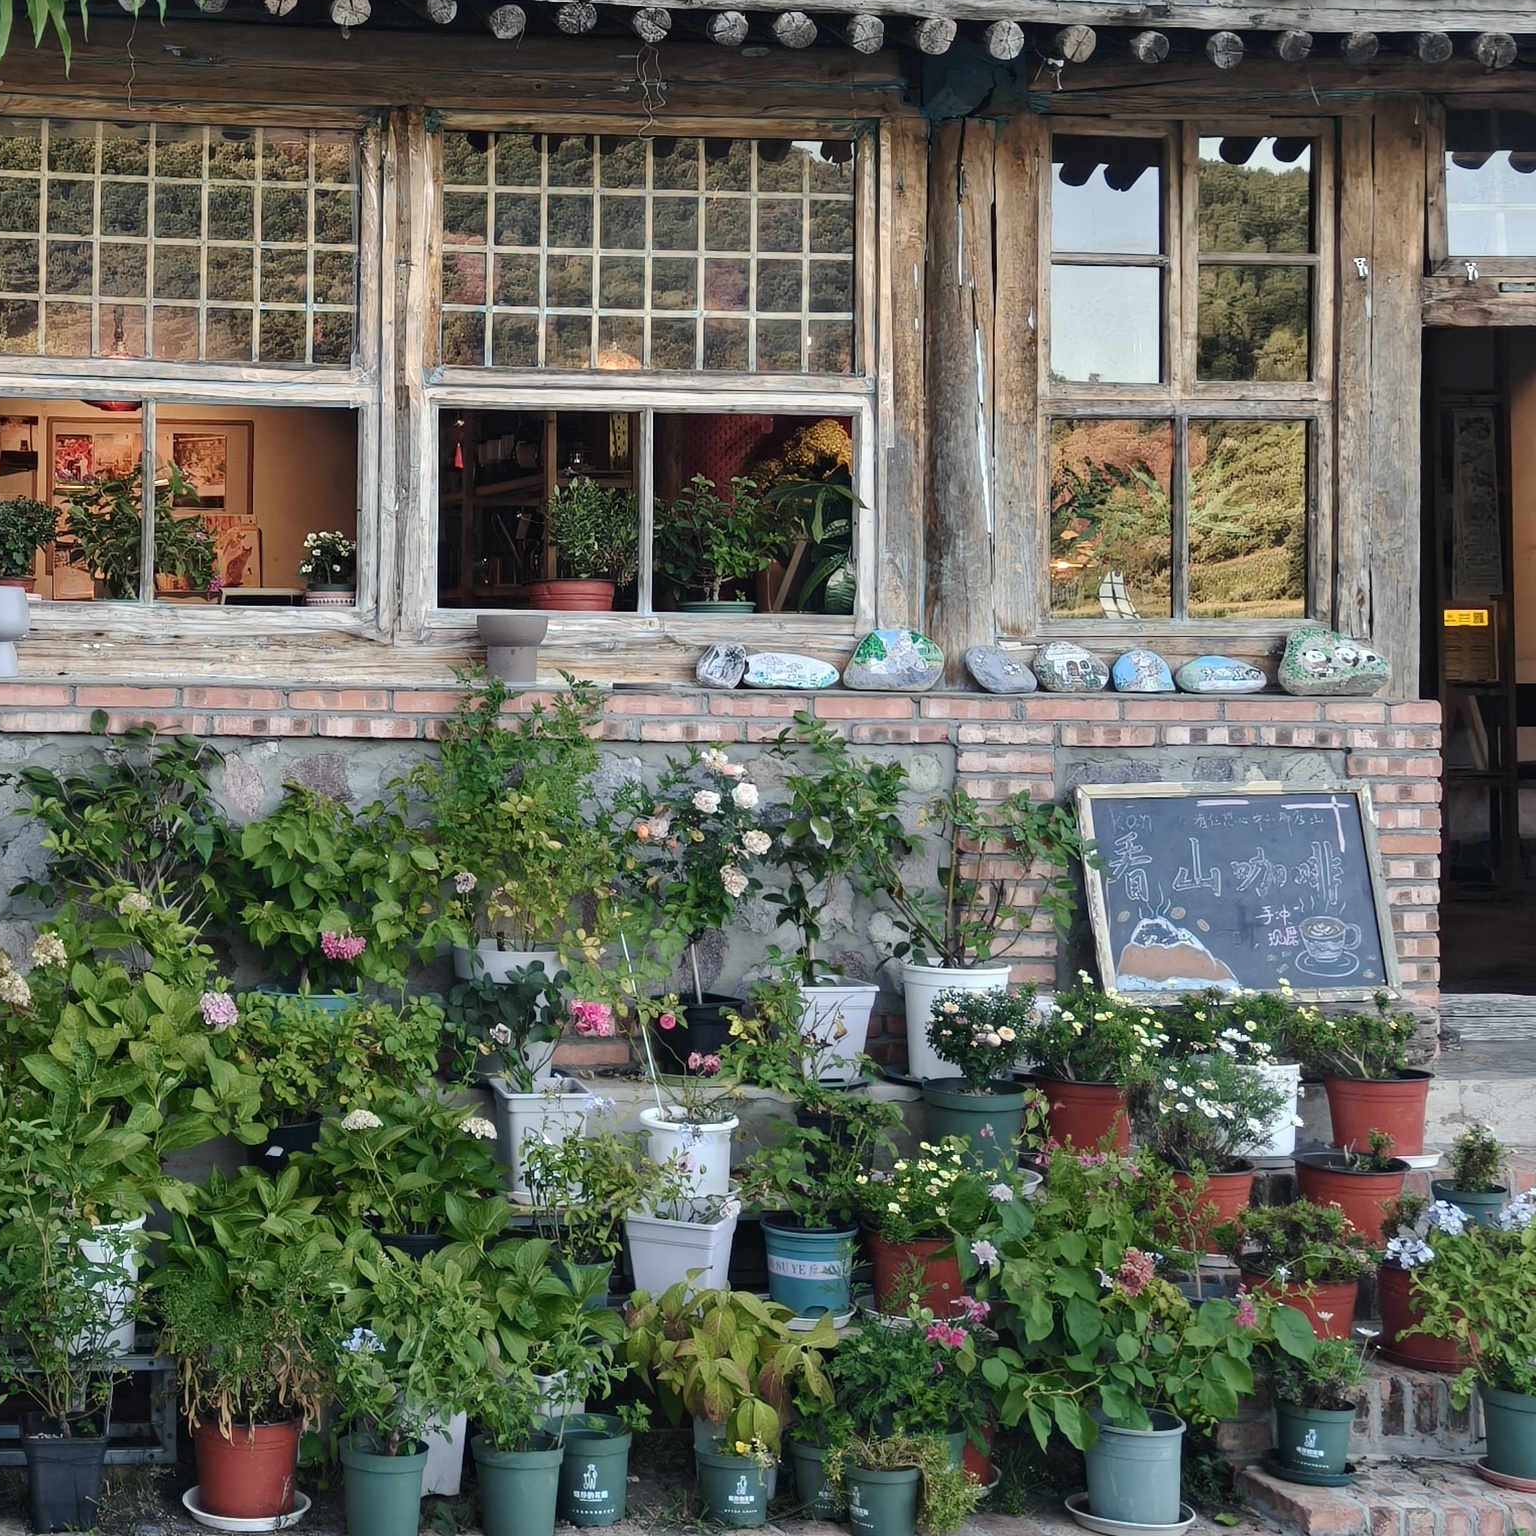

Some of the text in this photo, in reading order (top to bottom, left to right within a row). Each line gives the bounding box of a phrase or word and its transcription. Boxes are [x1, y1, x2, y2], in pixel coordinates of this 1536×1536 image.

[1108, 831, 1346, 905] 看山咖啡
[1255, 904, 1291, 926] 手冲
